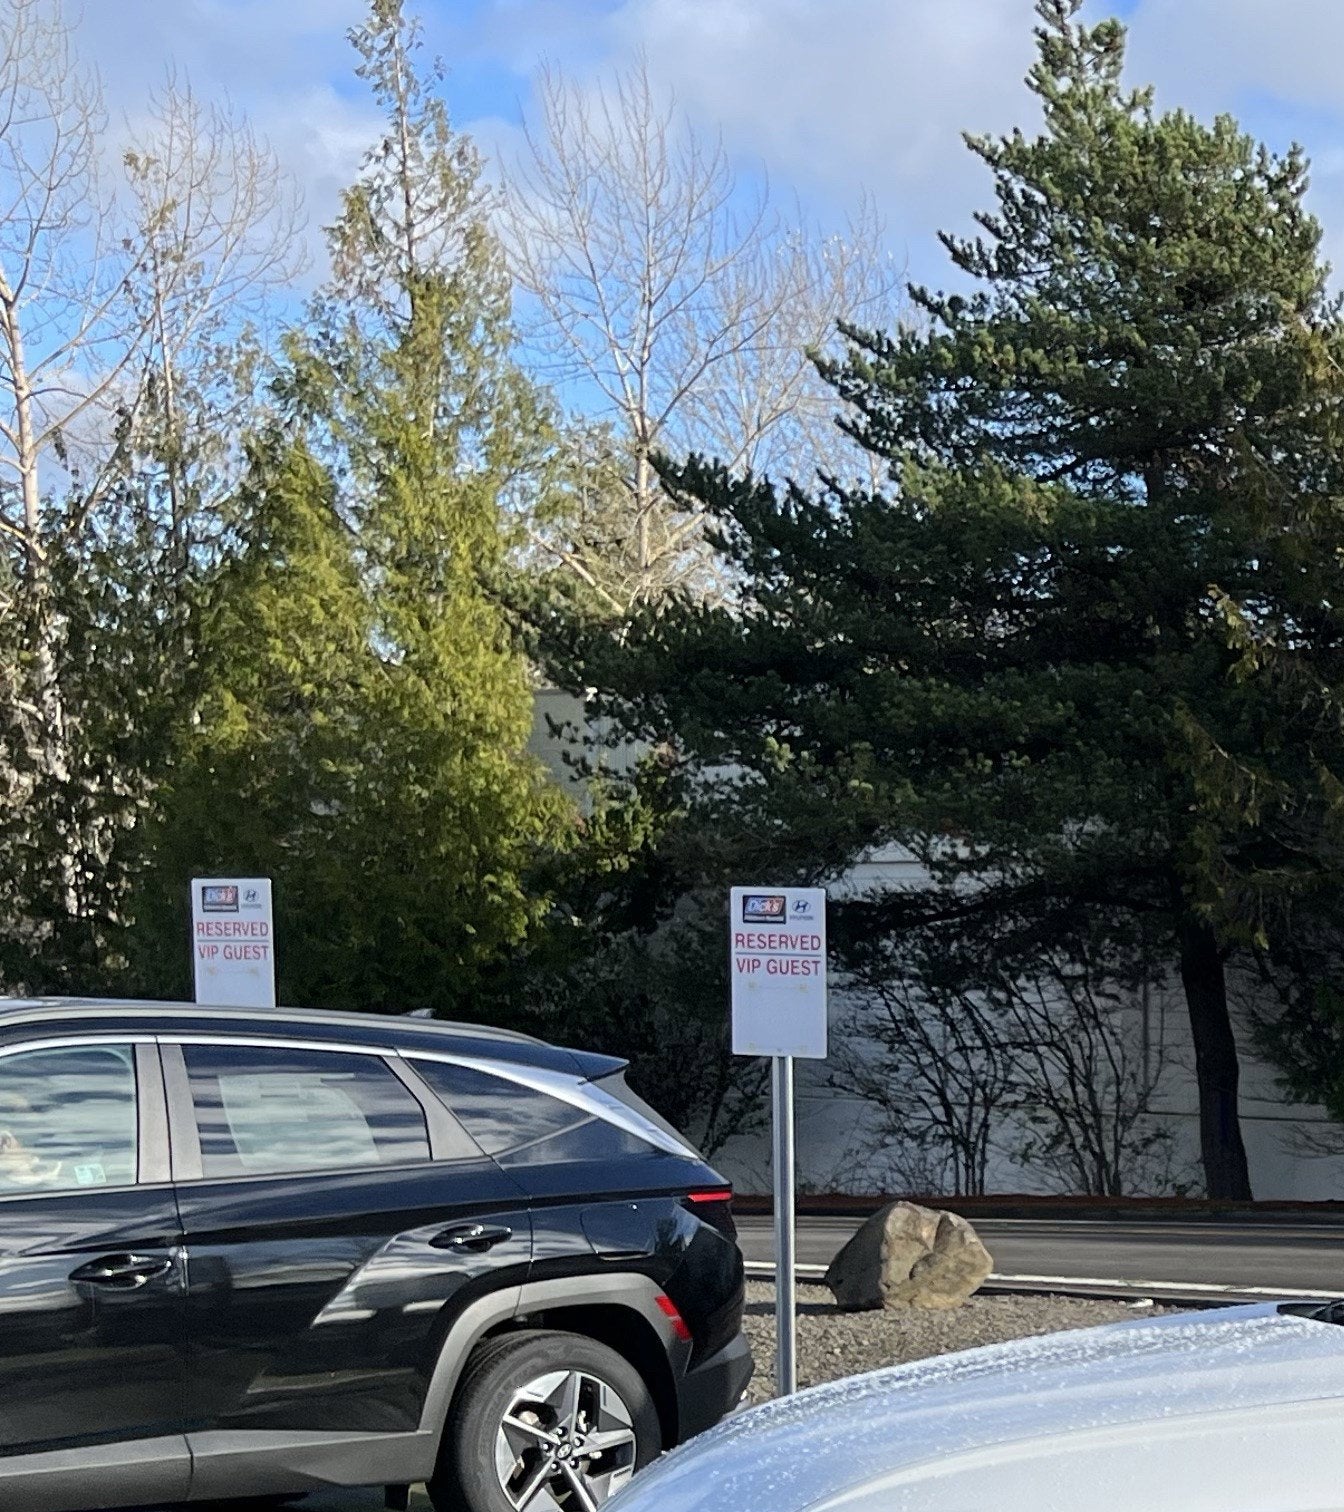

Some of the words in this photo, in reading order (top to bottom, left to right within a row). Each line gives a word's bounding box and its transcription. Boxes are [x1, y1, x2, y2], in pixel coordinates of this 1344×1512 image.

[196, 922, 269, 937] RESERVED
[735, 933, 821, 951] RESERVED
[198, 944, 219, 959] VIP
[223, 945, 269, 960] GUEST
[736, 958, 761, 974] VIP
[766, 959, 821, 976] GUEST
